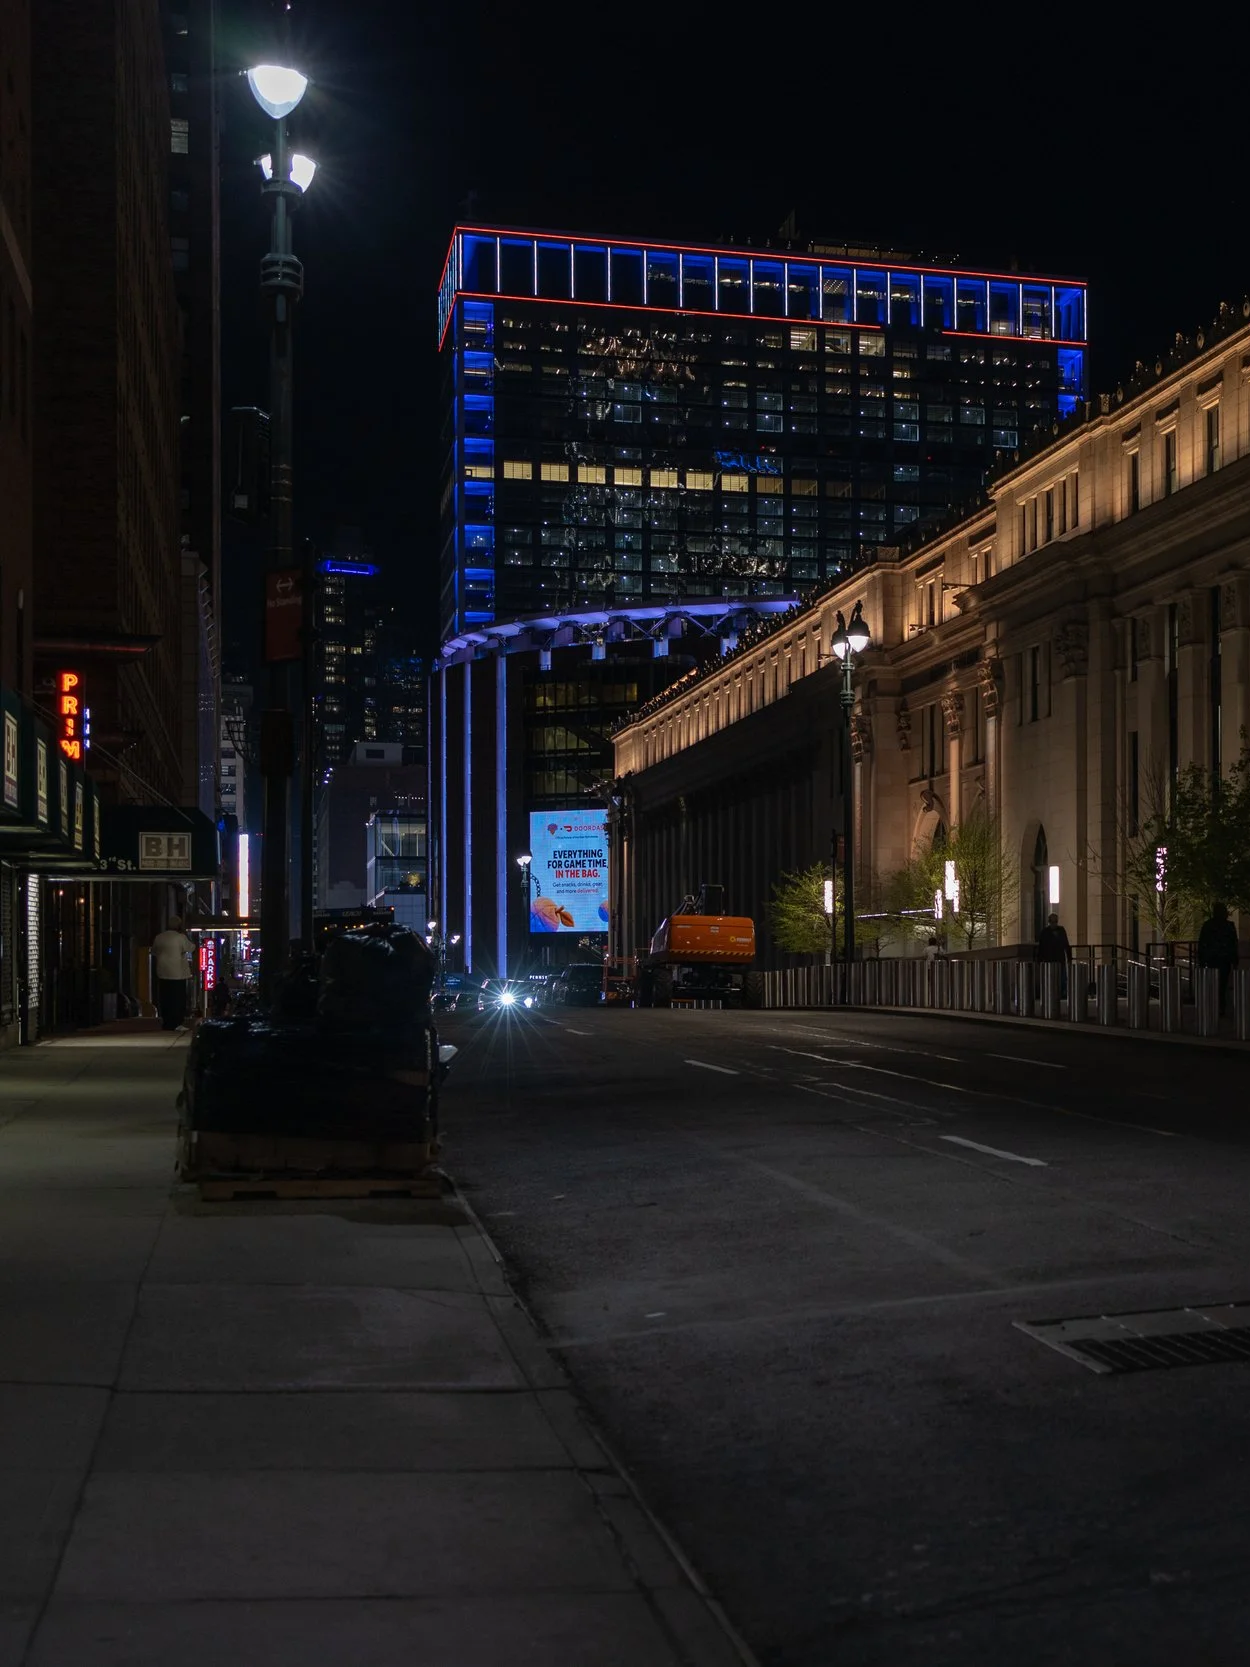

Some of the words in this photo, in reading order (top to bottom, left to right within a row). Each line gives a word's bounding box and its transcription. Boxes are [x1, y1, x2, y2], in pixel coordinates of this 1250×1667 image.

[553, 849, 603, 859] EVERYTHING
[117, 859, 137, 871] St.
[547, 860, 563, 869] FOR
[564, 859, 586, 869] GAME
[555, 869, 564, 878] IN
[565, 869, 580, 878] THE
[582, 869, 600, 878] BAG.
[207, 950, 215, 981] PARK
